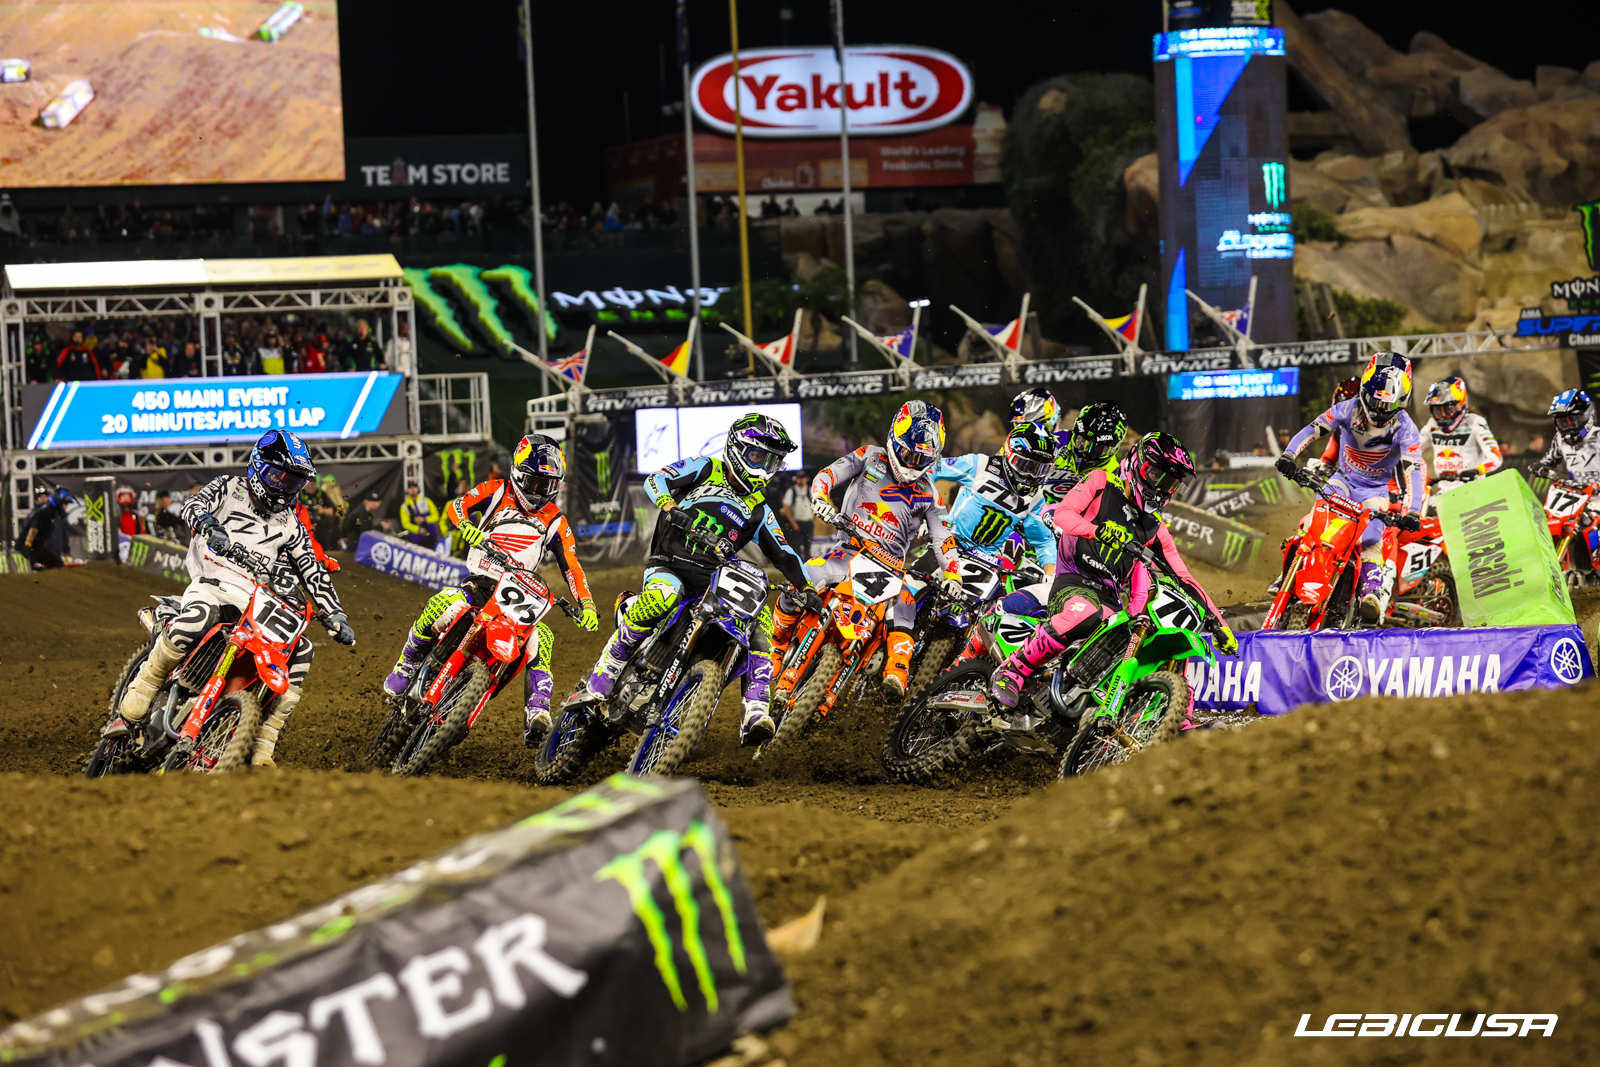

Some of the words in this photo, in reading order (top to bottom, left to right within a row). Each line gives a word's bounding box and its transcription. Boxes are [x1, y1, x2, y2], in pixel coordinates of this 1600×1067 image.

[739, 72, 927, 112] Yakult
[361, 157, 428, 187] TEAM
[432, 162, 511, 185] STORE
[131, 391, 170, 411] 450
[174, 388, 225, 409] MAIN
[228, 386, 289, 407] EVENT
[101, 414, 128, 434] 20
[131, 408, 272, 433] MINUTES/PLUS
[274, 409, 286, 427] 1
[289, 407, 325, 427] LAP
[977, 480, 1030, 515] FLY
[1330, 497, 1361, 514] RENTHAL
[1549, 492, 1581, 512] 17
[725, 508, 745, 528] YAMAHA
[851, 514, 875, 535] Red
[873, 525, 898, 543] Bull
[1320, 518, 1350, 543] 1
[1410, 548, 1432, 574] 51
[1459, 498, 1525, 600] Kawasaki
[392, 548, 461, 587] YAMAHA
[962, 563, 994, 597] 2
[717, 571, 765, 616] 3
[853, 571, 895, 599] 4
[255, 600, 299, 644] 12
[499, 587, 540, 624] 96
[1154, 590, 1199, 633] 70
[429, 661, 452, 697] DUNLOP
[658, 658, 680, 698] DUNLOP
[1104, 674, 1121, 708] DUNLOP
[1366, 653, 1500, 698] YAMAHA
